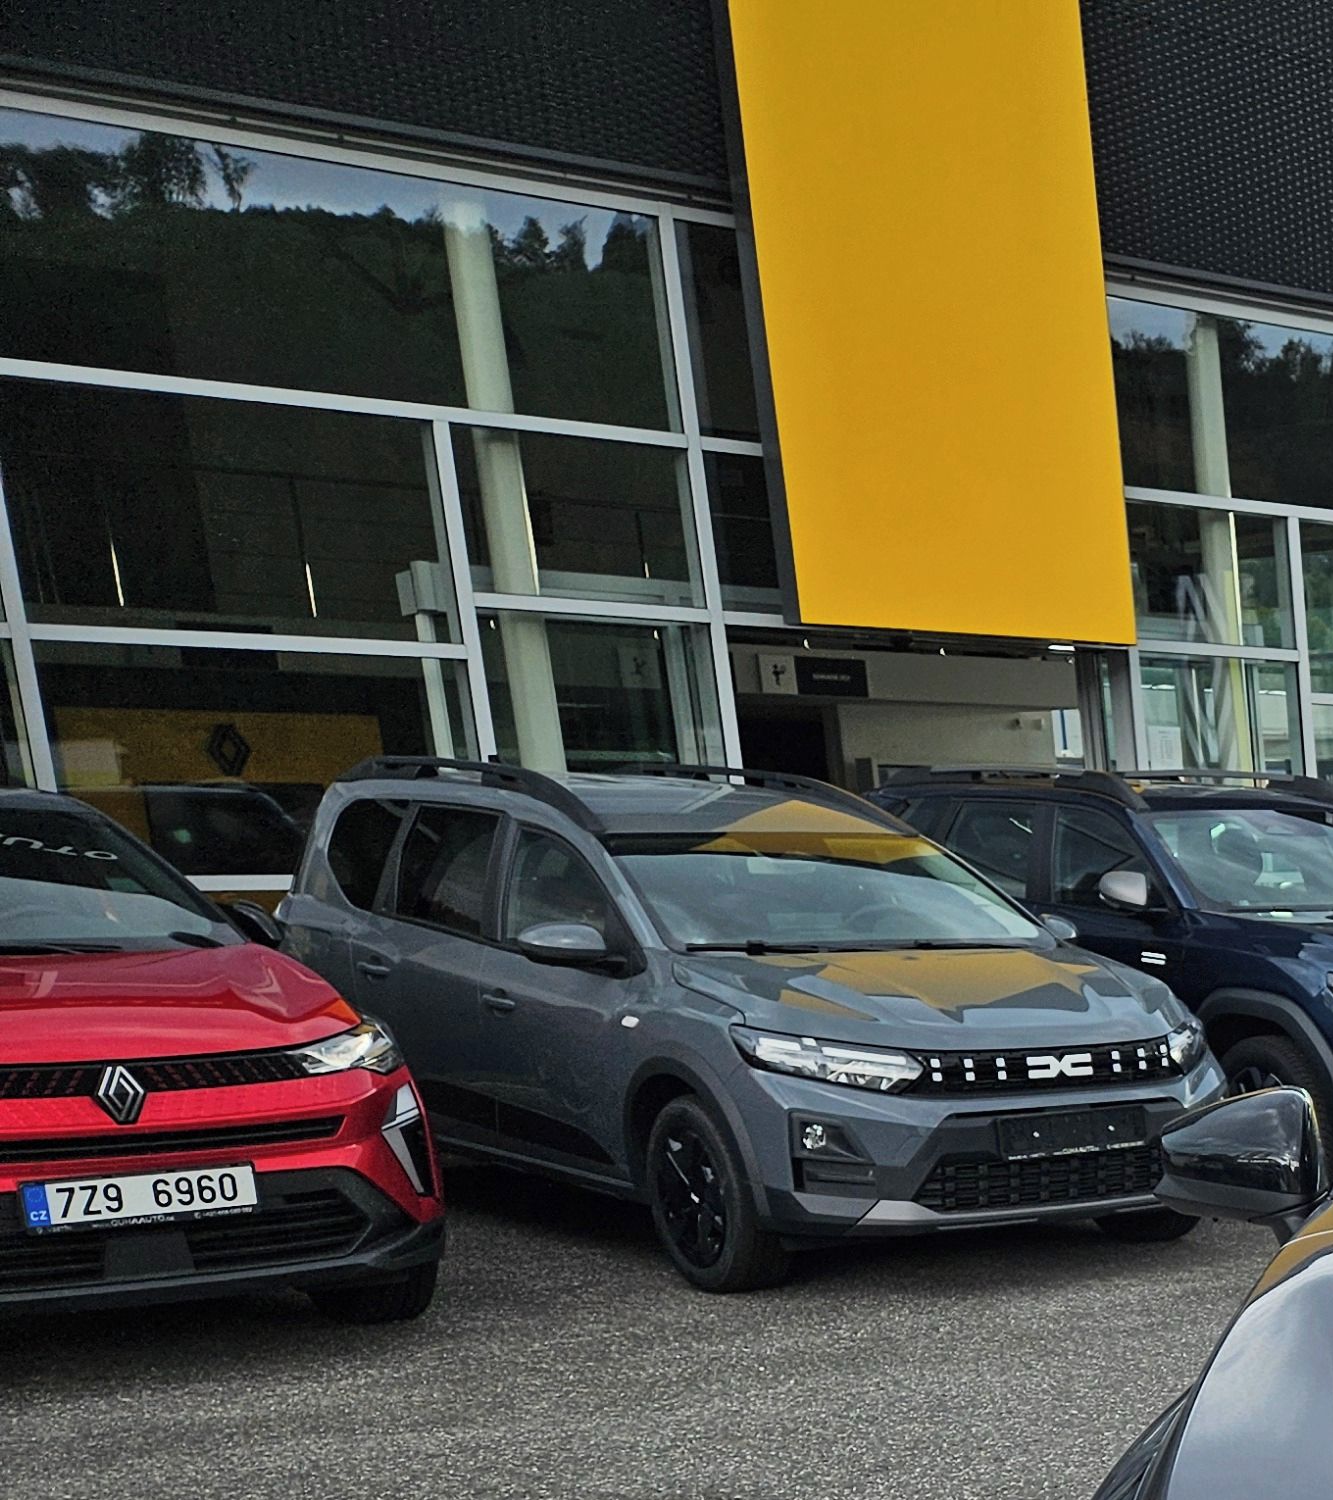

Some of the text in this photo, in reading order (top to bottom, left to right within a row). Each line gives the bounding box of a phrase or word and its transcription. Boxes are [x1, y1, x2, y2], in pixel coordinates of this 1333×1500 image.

[55, 1172, 238, 1219] 7Z9 6960
[30, 1210, 48, 1221] CZ
